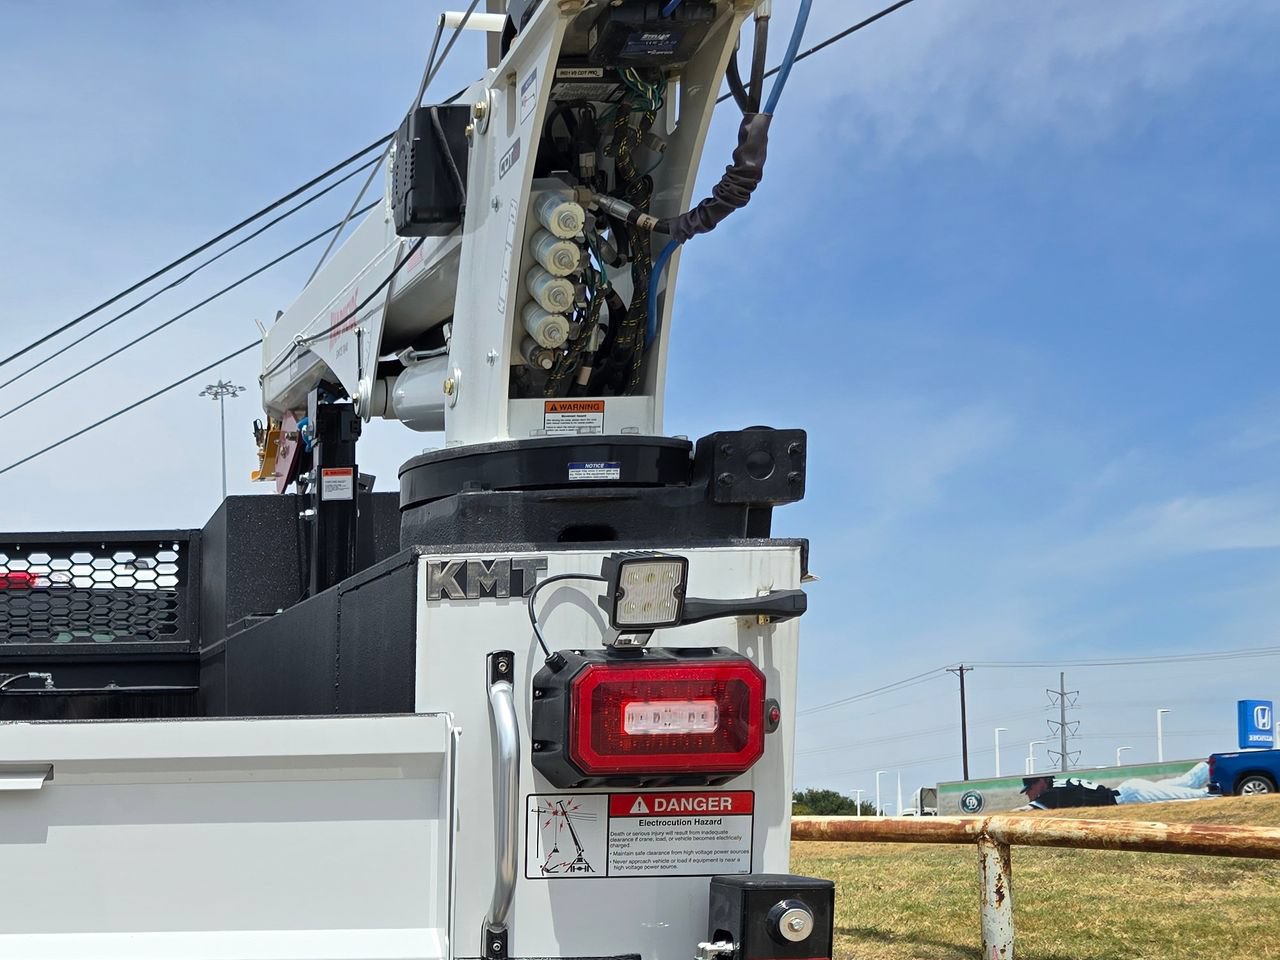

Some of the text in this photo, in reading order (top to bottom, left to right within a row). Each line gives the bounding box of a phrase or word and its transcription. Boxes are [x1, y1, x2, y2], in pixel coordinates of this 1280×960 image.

[560, 403, 600, 411] WARNING
[426, 556, 548, 601] KMT
[654, 797, 733, 812] DANGER
[639, 818, 722, 827] Electrocution Hazard
